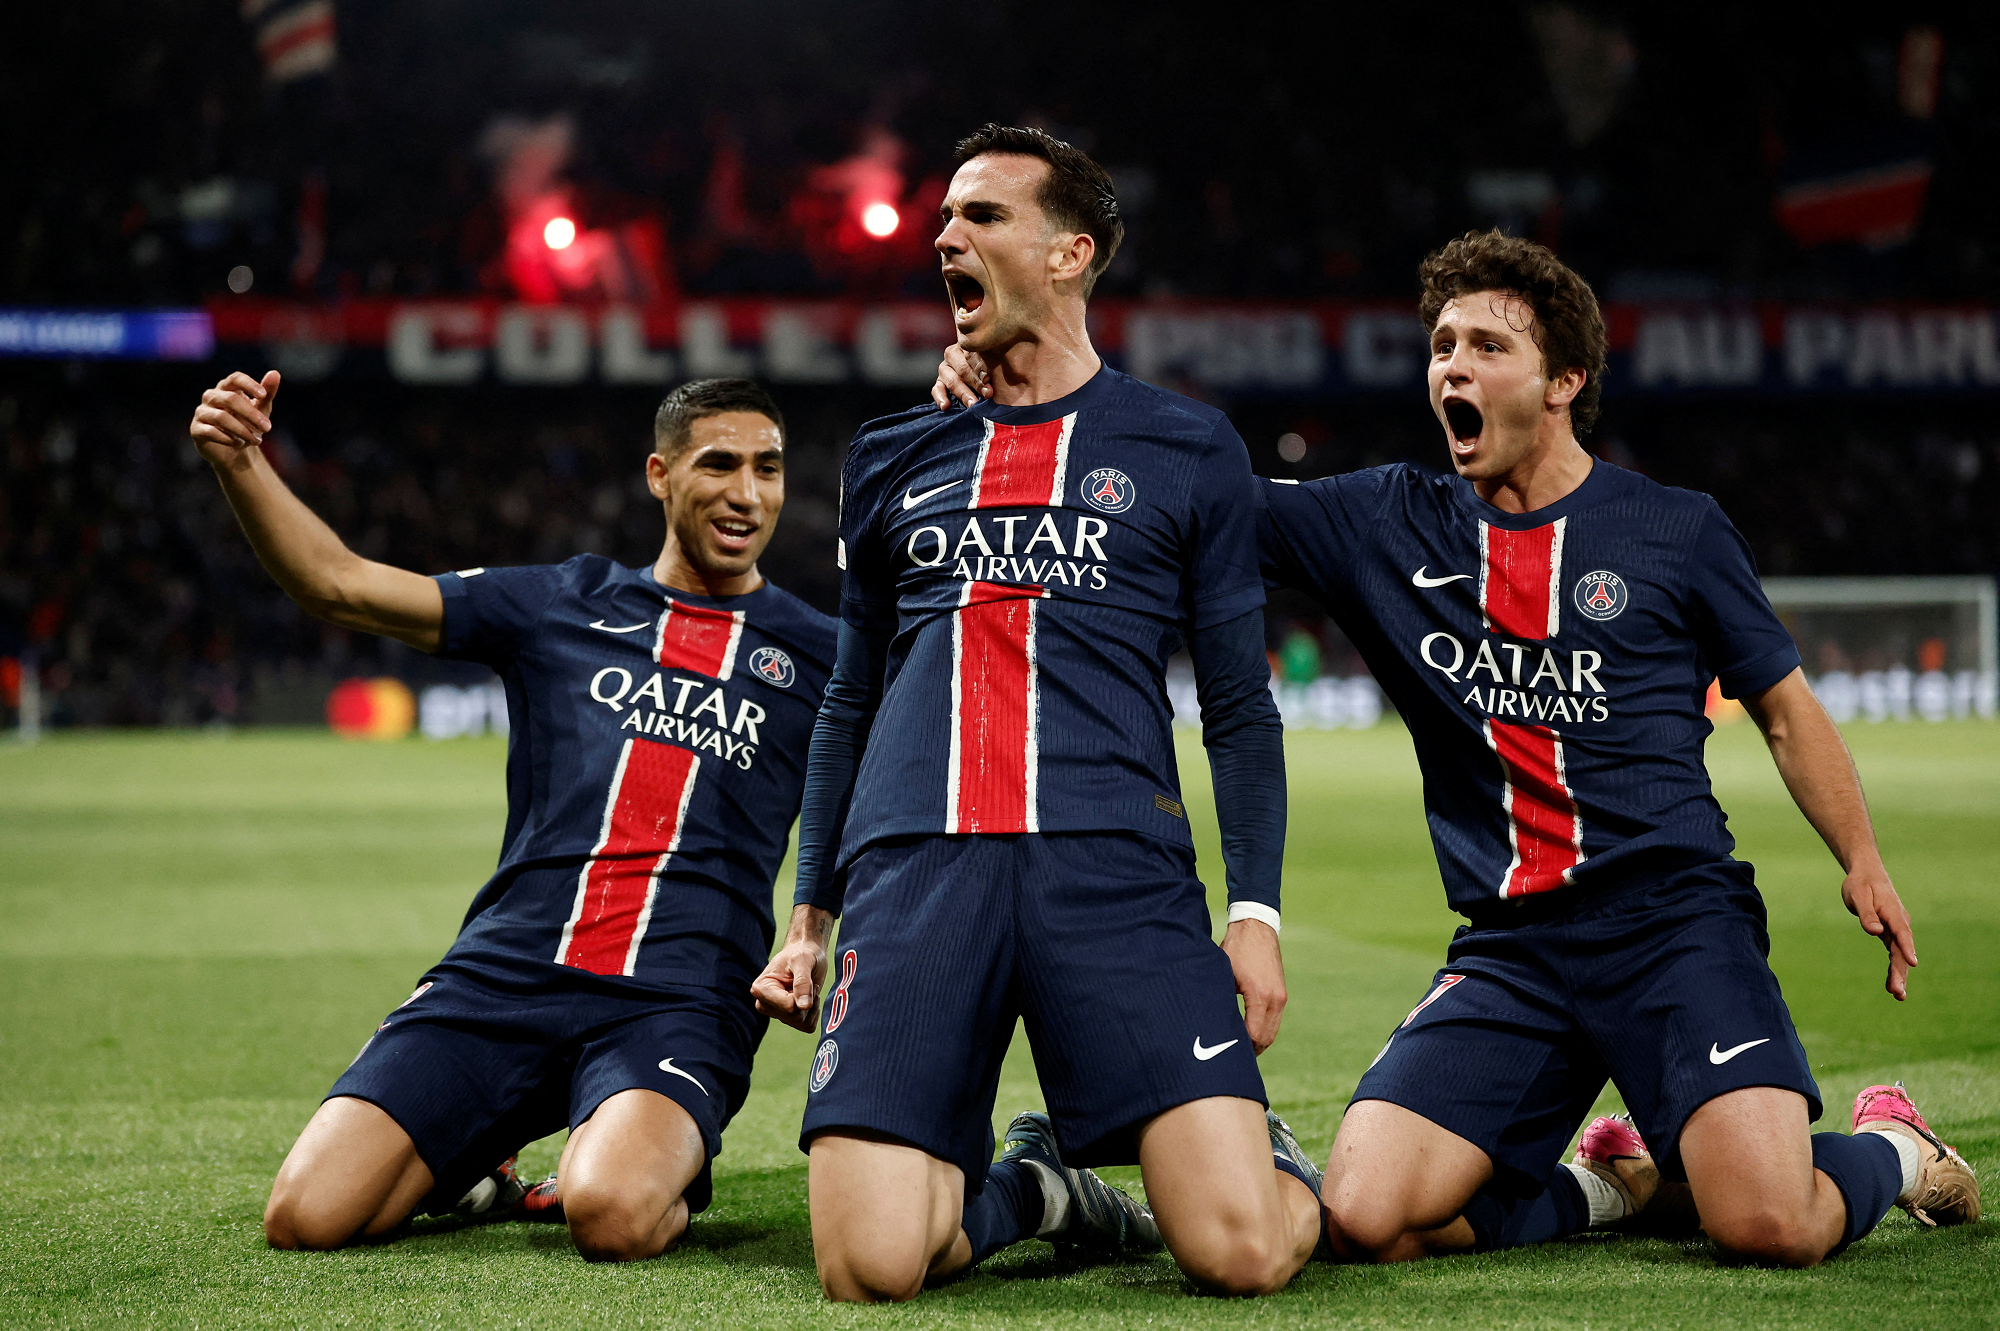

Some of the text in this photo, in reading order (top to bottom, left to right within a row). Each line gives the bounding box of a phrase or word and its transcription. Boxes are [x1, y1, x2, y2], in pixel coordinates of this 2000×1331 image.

[390, 306, 945, 382] COLLEC
[1092, 471, 1127, 484] PARIS
[908, 513, 1109, 567] QATAR
[952, 556, 1107, 590] AIRWAYS
[1584, 573, 1619, 586] PARIS
[760, 650, 790, 667] PARIS
[1420, 632, 1606, 693] QATAR
[589, 667, 766, 745] QATAR
[1463, 685, 1609, 723] AIRWAYS
[621, 708, 756, 770] AIRWAYS
[825, 949, 857, 1034] 8
